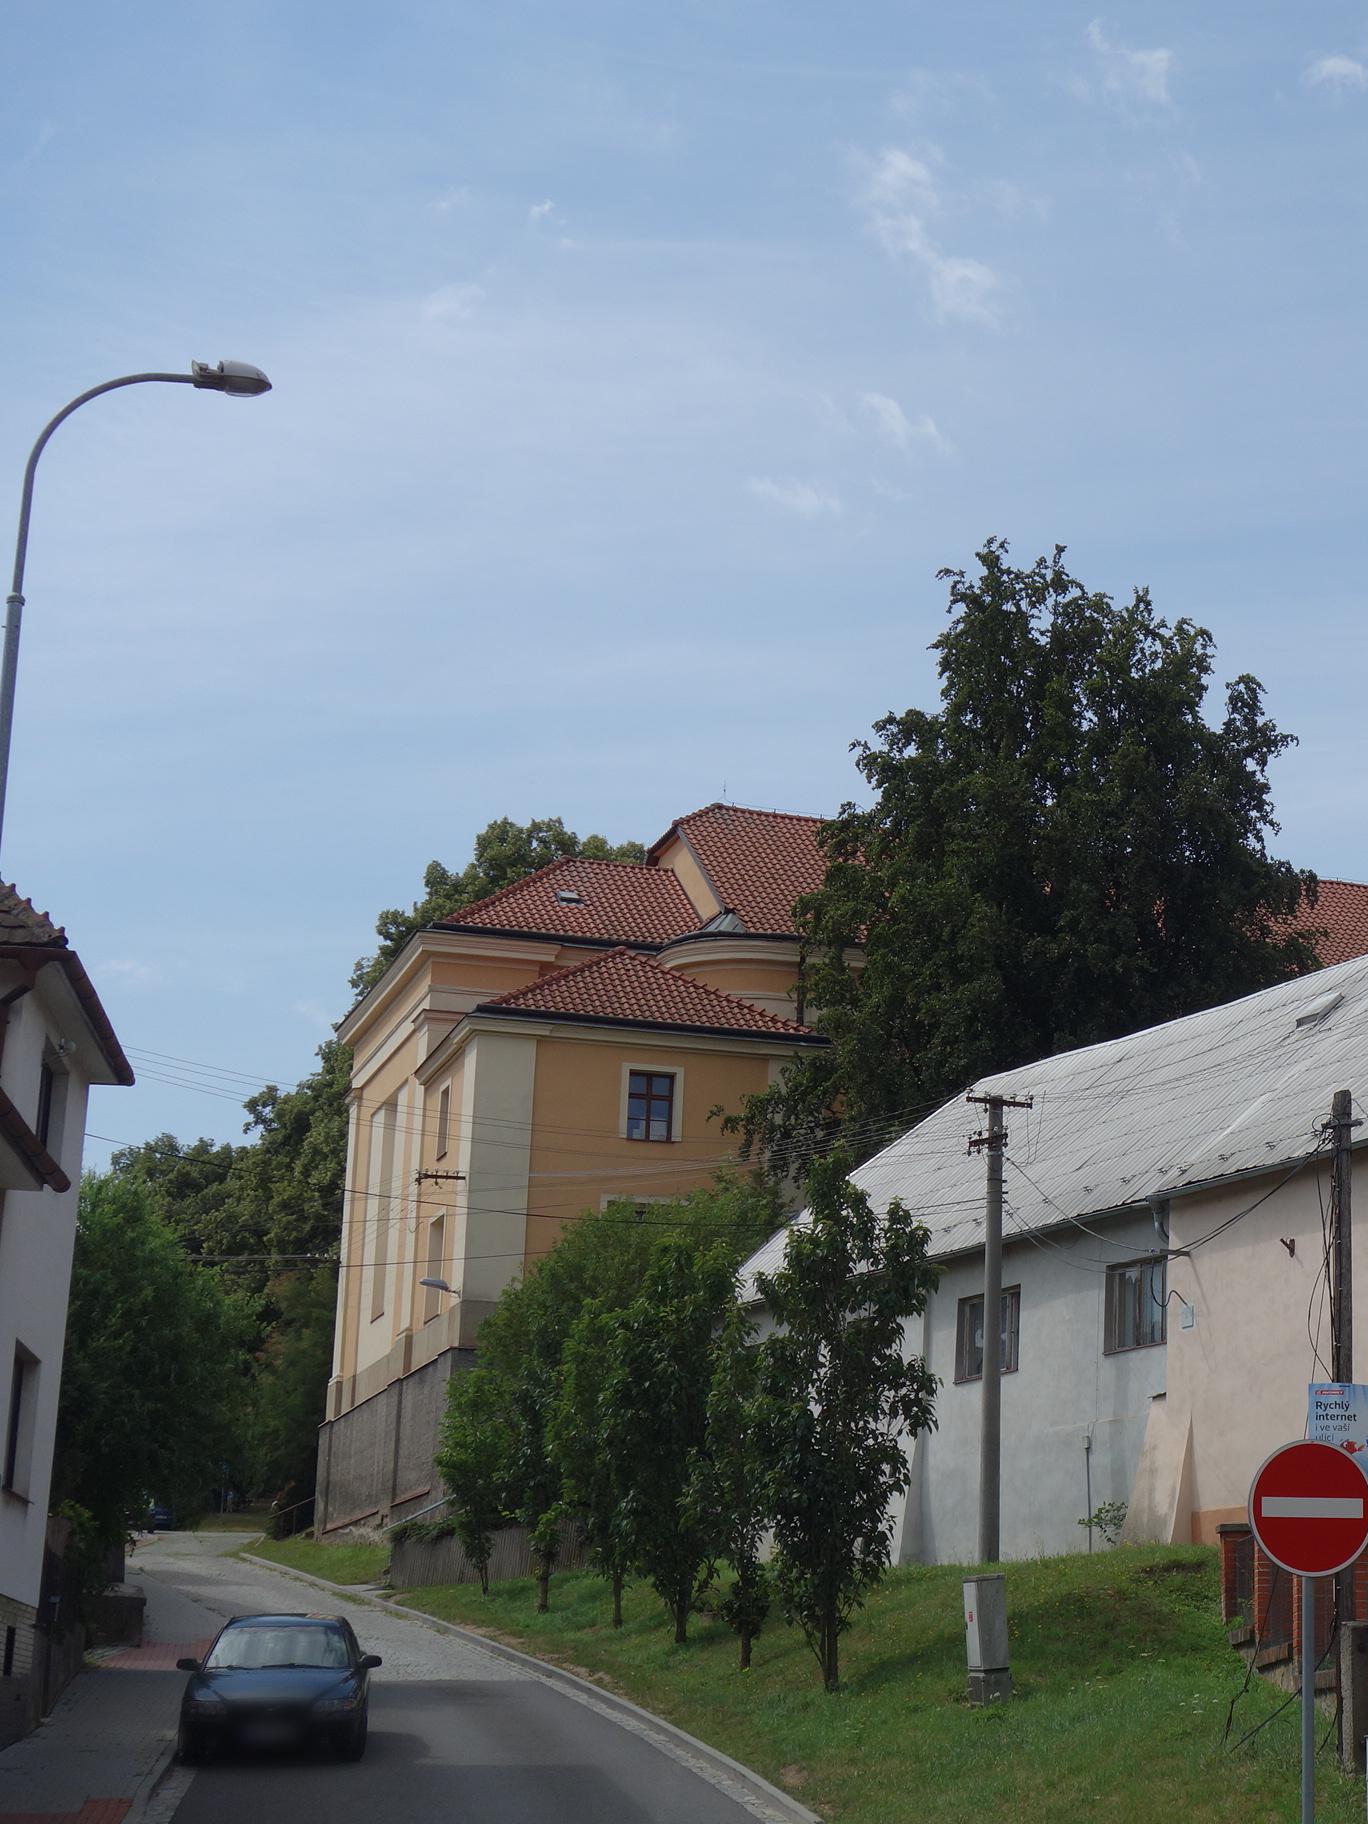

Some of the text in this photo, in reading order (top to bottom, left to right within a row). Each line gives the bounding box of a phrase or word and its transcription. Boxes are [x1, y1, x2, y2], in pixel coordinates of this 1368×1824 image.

[1315, 1400, 1350, 1412] Rychlý
[1315, 1411, 1357, 1422] internet
[1332, 1423, 1350, 1431] vaší
